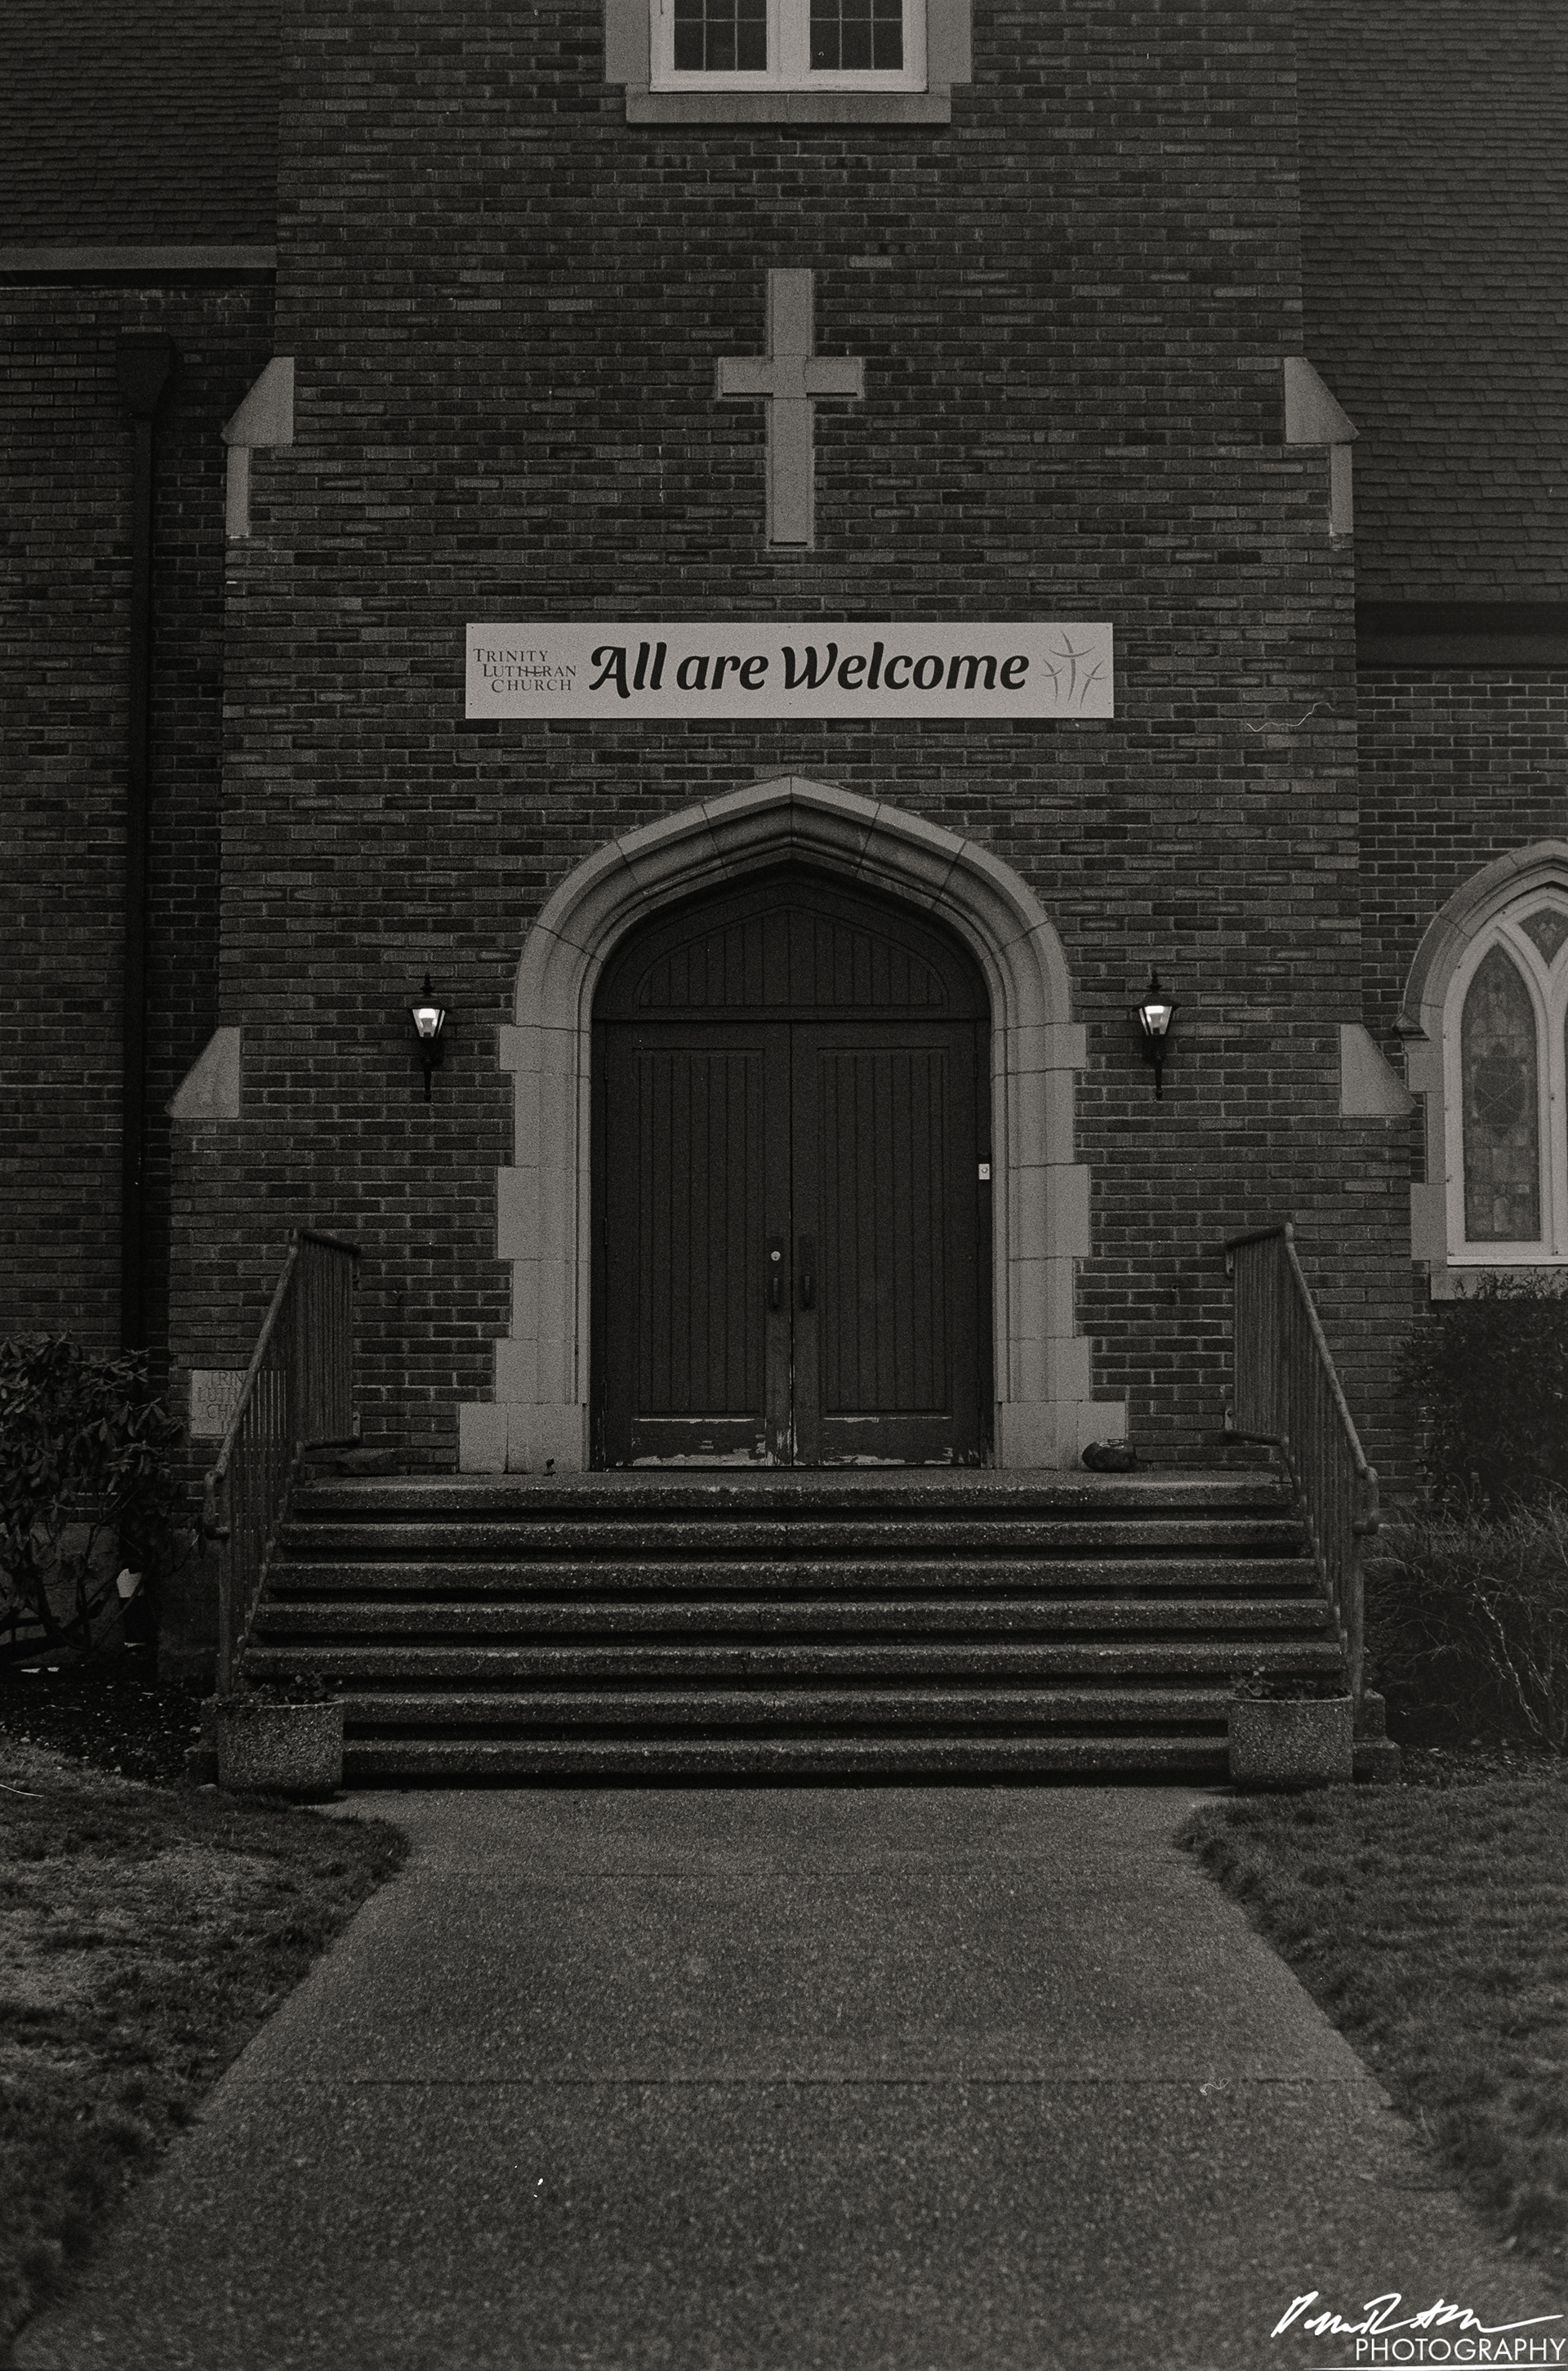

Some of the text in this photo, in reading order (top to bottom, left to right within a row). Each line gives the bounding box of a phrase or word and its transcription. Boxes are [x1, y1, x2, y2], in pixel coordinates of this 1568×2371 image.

[473, 648, 549, 662] TRINITY
[483, 664, 577, 678] LUTHERAN
[588, 641, 1030, 698] All are Welcome
[491, 679, 572, 693] CHURCH
[208, 1371, 247, 1385] TRIN
